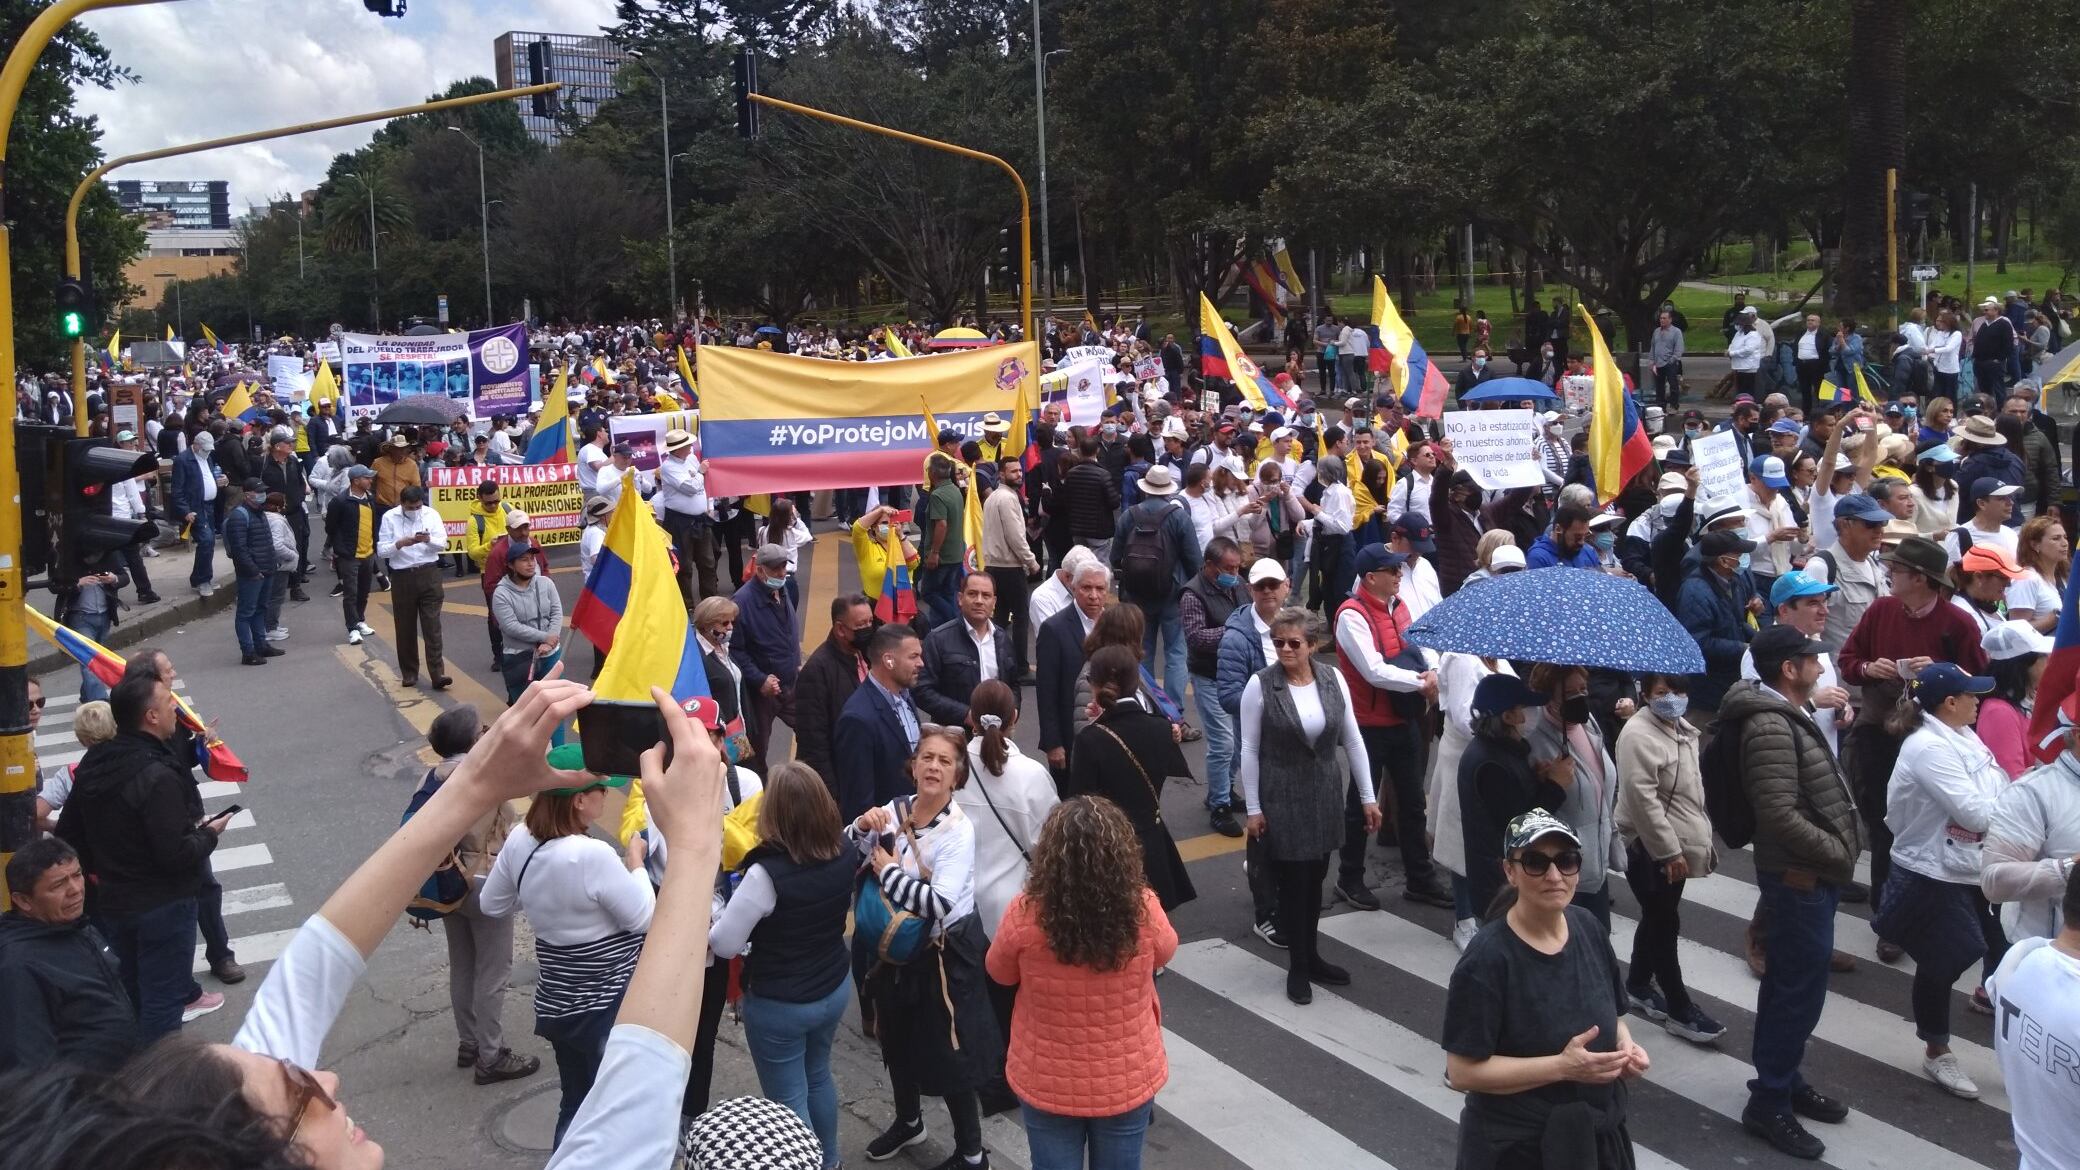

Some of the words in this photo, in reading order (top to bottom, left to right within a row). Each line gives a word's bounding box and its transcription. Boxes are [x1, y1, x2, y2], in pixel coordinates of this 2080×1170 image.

[347, 346, 365, 354] DEL
[367, 346, 402, 354] PUEBLO
[405, 344, 464, 353] TRABAJADOR
[380, 353, 392, 361] SE
[768, 417, 985, 446] #YoProtejoMPaís
[1470, 424, 1476, 432] a
[1479, 422, 1487, 431] la
[1489, 420, 1531, 432] estatización
[1465, 438, 1504, 448] nuestros
[1458, 452, 1503, 463] ensionales
[1505, 452, 1514, 461] de
[1515, 452, 1531, 461] toda
[438, 466, 558, 486] MARCHAMOS
[563, 464, 578, 481] P
[1483, 468, 1491, 478] la
[438, 488, 452, 501] EL
[455, 488, 480, 501] RES
[502, 487, 509, 499] A
[511, 486, 521, 499] LA
[524, 483, 568, 498] PROPIEDAD
[570, 482, 582, 495] PR
[524, 497, 582, 514] INVASIONES
[535, 516, 565, 529] INTEGRIDAD
[566, 515, 573, 527] DE
[541, 531, 558, 545] LAS
[559, 530, 582, 542] PENS
